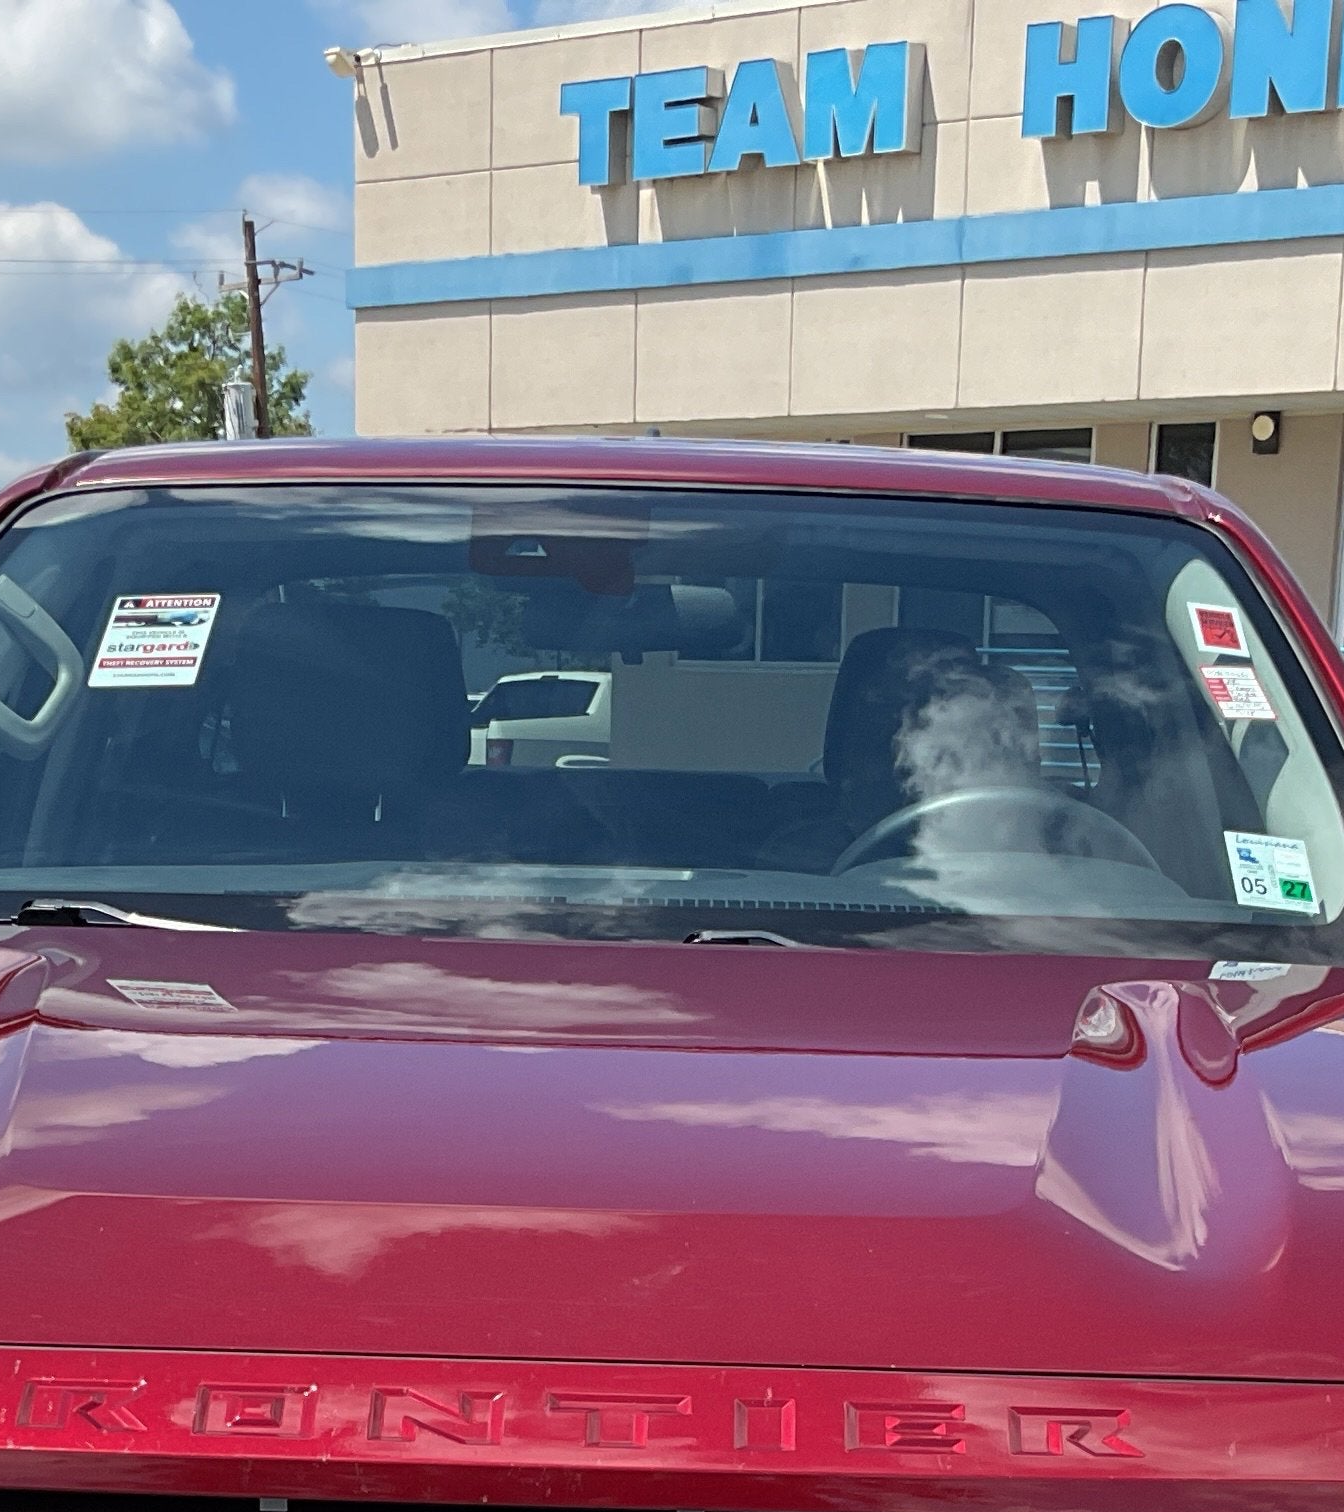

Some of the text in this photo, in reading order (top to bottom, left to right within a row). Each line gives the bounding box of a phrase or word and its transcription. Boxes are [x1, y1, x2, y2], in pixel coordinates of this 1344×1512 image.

[560, 40, 912, 186] TEAM
[145, 598, 212, 608] ATTENTION
[1240, 876, 1268, 895] 05
[1282, 880, 1309, 899] 27
